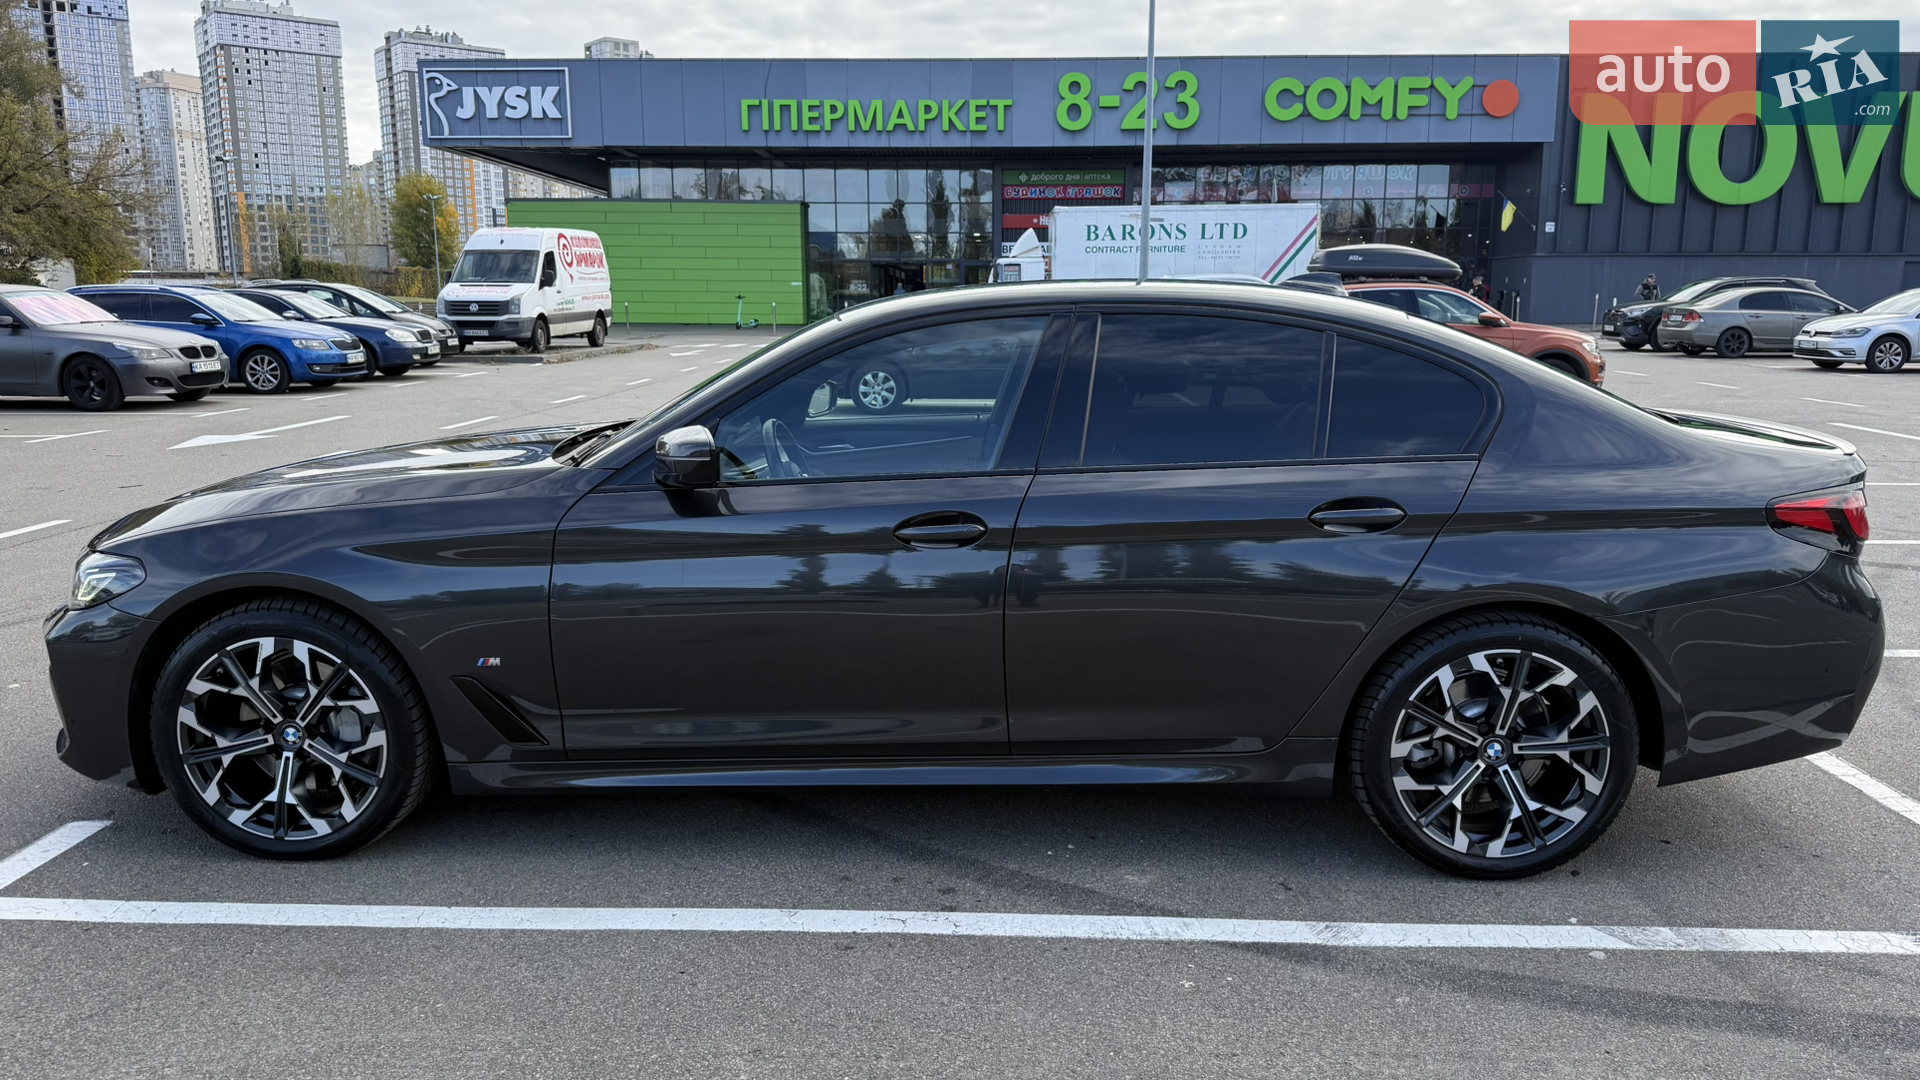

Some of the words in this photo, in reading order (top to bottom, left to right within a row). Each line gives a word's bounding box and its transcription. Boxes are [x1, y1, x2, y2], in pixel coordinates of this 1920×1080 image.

[455, 86, 563, 120] JYSK
[1056, 71, 1200, 132] 8-23
[1265, 76, 1475, 121] COMFY
[740, 99, 1013, 132] ГІПЕРМАРКЕТ
[1031, 172, 1063, 181] доброго
[1004, 187, 1064, 198] БУДИНОК
[1200, 223, 1248, 240] LTD
[1085, 246, 1133, 254] CONTRACT
[1136, 245, 1186, 253] FRNITURE
